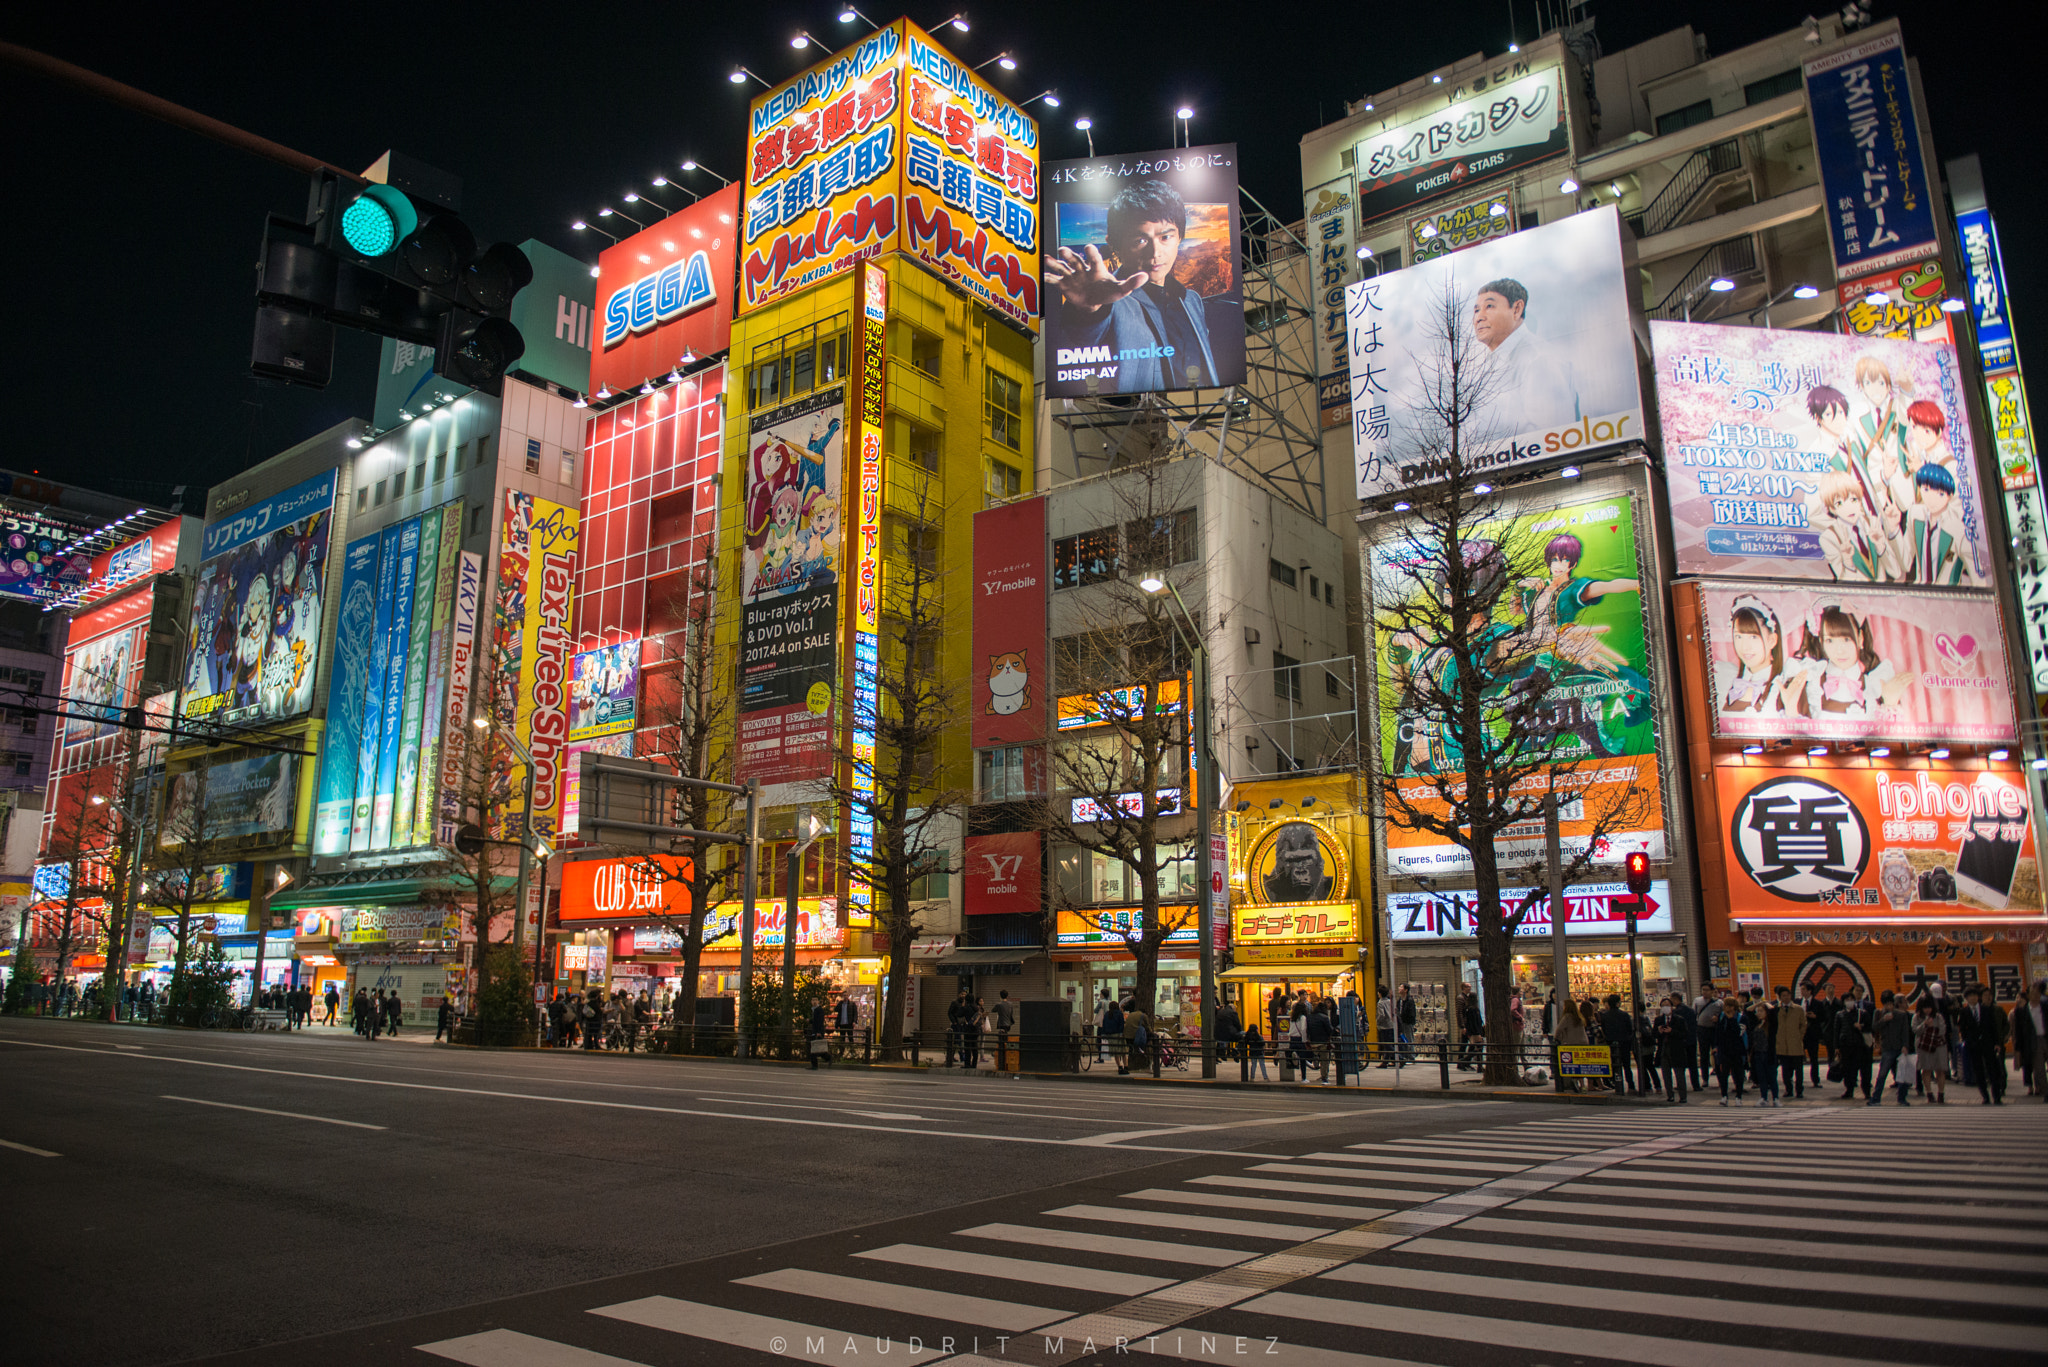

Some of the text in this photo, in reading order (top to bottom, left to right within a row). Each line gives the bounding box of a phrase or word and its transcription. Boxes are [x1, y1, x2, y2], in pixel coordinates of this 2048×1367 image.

[1810, 36, 1895, 71] AMENITY DREAM
[752, 28, 899, 137] MEDIAリサイクル
[910, 34, 1037, 149] MEDIAリサイクル
[751, 68, 896, 186] 激安販売
[910, 75, 1036, 199] 激安販売
[1369, 85, 1549, 178] メイドカジノ
[1052, 153, 1232, 184] 4Kをみんなのものに。
[1841, 63, 1900, 248] アメニティードリーム
[746, 124, 895, 243] 高額買取
[1416, 152, 1505, 193] POKER STARS
[907, 133, 1036, 250] 高額買取
[1310, 202, 1351, 223] GeraGera
[1838, 196, 1861, 256] 秋葉原店
[1450, 216, 1506, 246] ゲラゲラ
[744, 194, 896, 305] Mulan
[904, 194, 1038, 315] Mulan
[1844, 247, 1933, 278] AMENITY DREAM
[603, 249, 717, 348] SEGA
[556, 294, 595, 352] HI
[866, 319, 883, 335] DVD
[1846, 299, 1945, 334] まんが
[865, 342, 883, 359] ゲーム
[868, 355, 880, 368] CD
[1057, 342, 1175, 366] DMM.make
[864, 376, 882, 391] アニメ
[1348, 281, 1396, 494] 次は太陽か。
[1332, 405, 1352, 422] 3F
[1992, 377, 2019, 429] まんが
[1543, 415, 1631, 453] solar
[1708, 420, 1798, 449] 4月3日より
[1680, 445, 1766, 470] TOKYO
[215, 488, 249, 514] Sofmap
[1712, 499, 1810, 528] 放送開始!
[208, 503, 273, 551] ソフマップ
[530, 507, 580, 550] AKKY
[2013, 491, 2038, 555] 喫茶室
[105, 535, 153, 591] SEGA
[987, 561, 1031, 577] ヤフーのモバイル
[458, 554, 479, 619] AKKY
[982, 576, 1036, 596] Y!mobile
[747, 596, 833, 625] Blu-rayボックス
[406, 516, 437, 741] メロンブックス秋葉原店
[747, 617, 814, 645] & DVD Vol.1
[864, 634, 877, 647] 中古
[746, 632, 831, 662] 2017.4.4 on SALE
[523, 551, 577, 811] Tax-free Shop
[864, 662, 877, 675] 中古
[1923, 673, 1999, 690] @home cafe
[447, 640, 472, 731] Tax-free
[863, 690, 876, 702] 中古
[743, 716, 778, 730] TOKYO MX
[766, 726, 781, 735] 23:30
[444, 733, 466, 786] Shop
[743, 743, 758, 752] AT-X
[241, 776, 271, 792] Pockets
[1876, 771, 2022, 820] iphone
[861, 836, 872, 847] 中古
[1748, 792, 1858, 888] 質
[1883, 821, 2026, 842] 携帯 スマホ
[981, 853, 1023, 882] Y!
[1398, 855, 1433, 866] Figures,
[1508, 847, 1536, 860] goods
[1560, 845, 1585, 856] more
[34, 861, 71, 899] SEGA
[594, 860, 663, 911] CLUB SEGA
[987, 883, 1018, 895] mobile
[1100, 879, 1119, 892] 2階
[1589, 883, 1628, 894] & MANGA
[1570, 899, 1610, 921] ZIN
[1826, 888, 1880, 906] 大黒屋
[358, 909, 424, 928] Tax-free Shop
[1241, 913, 1350, 936] ゴーゴーカレー
[1396, 895, 1463, 937] ZIN
[1927, 943, 1993, 961] チケット
[1902, 964, 2023, 1007] 大黒屋
